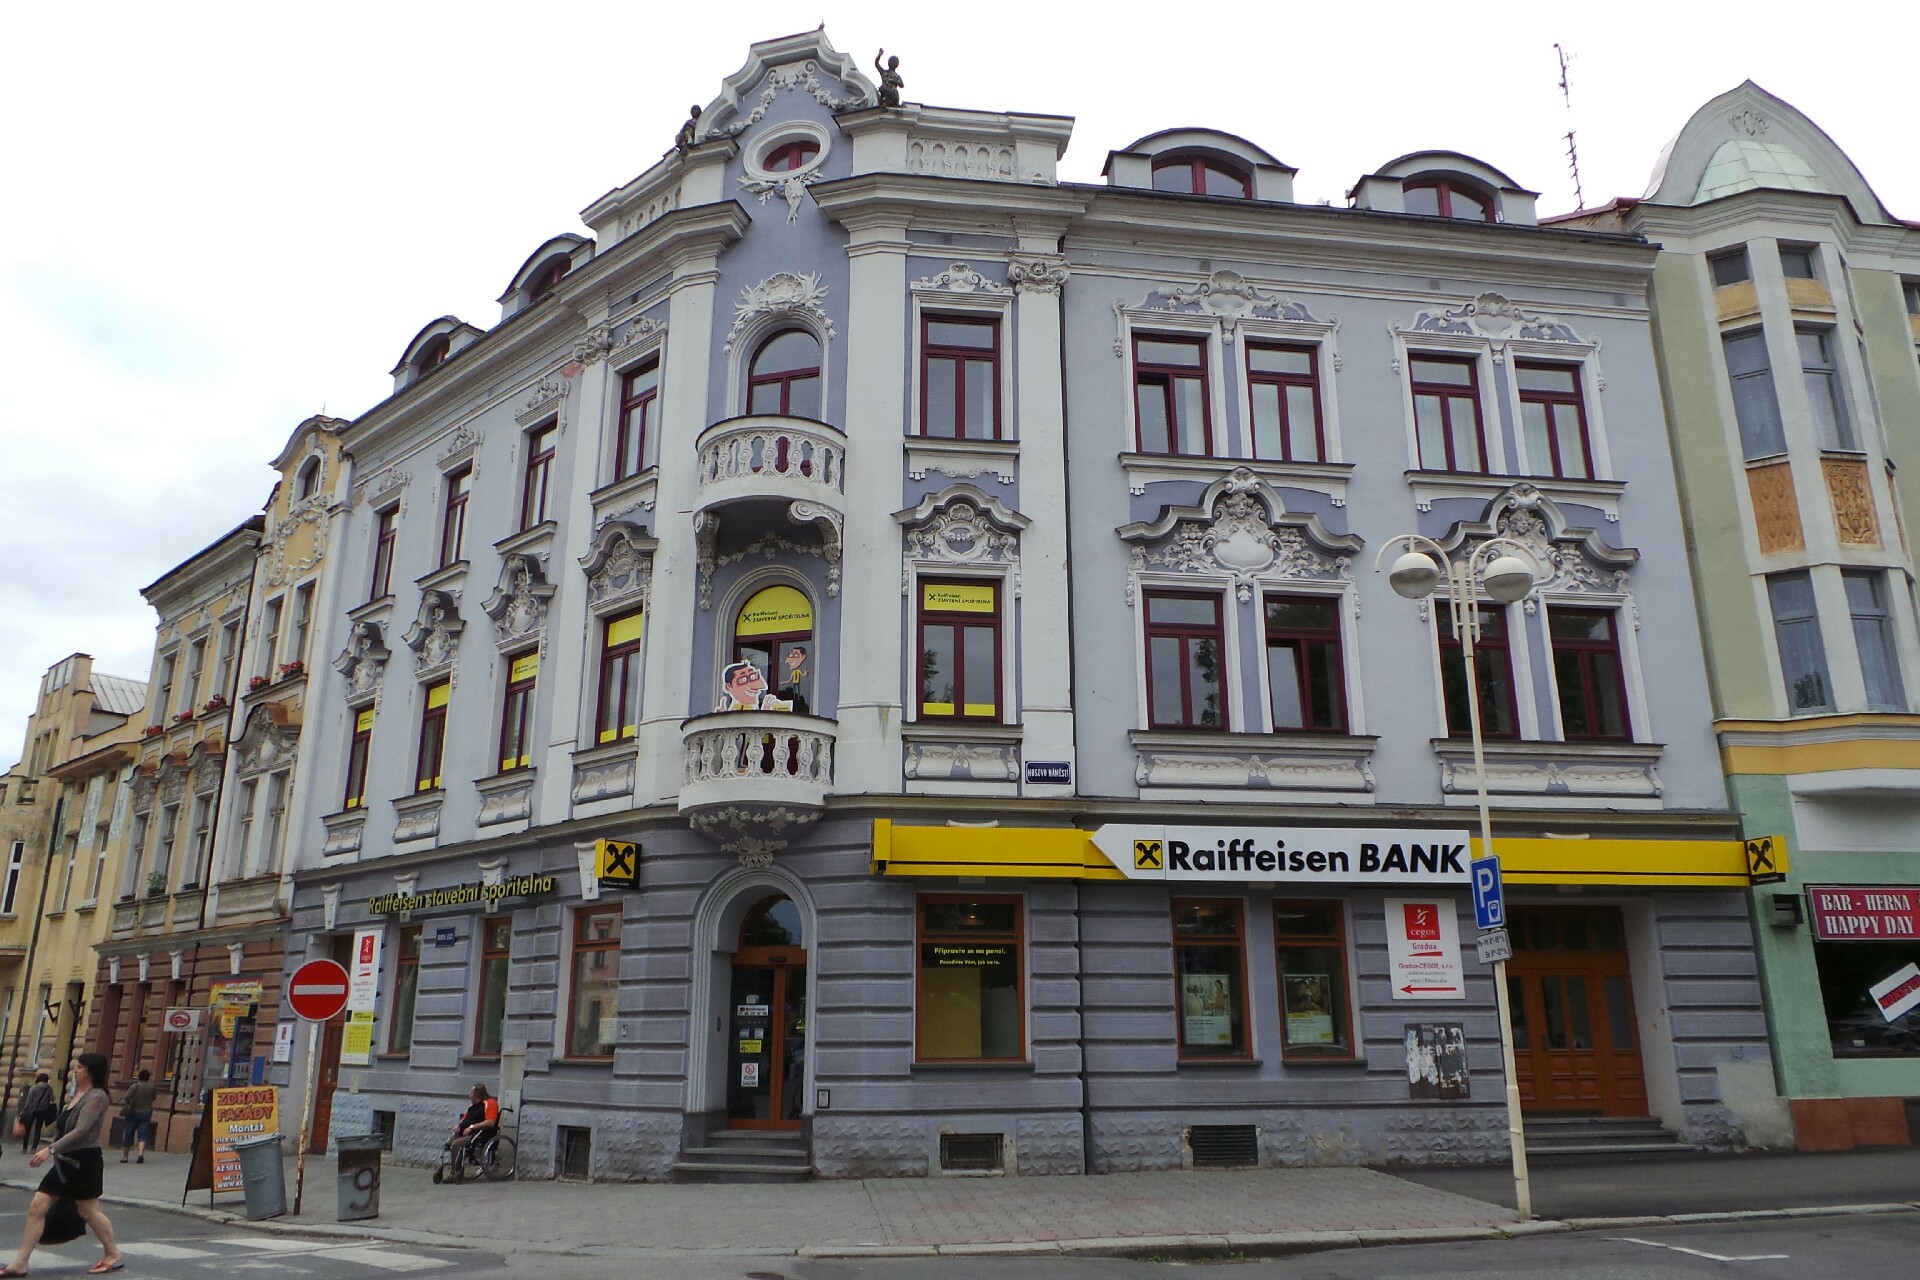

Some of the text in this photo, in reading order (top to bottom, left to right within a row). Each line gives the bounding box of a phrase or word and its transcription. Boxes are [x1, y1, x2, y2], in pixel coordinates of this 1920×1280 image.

[1028, 768, 1047, 777] HUSOVO
[1168, 838, 1466, 874] Raiffeisen BANK
[369, 874, 554, 914] Raiffeisen stavební spořitelna
[1476, 868, 1494, 908] P
[1821, 895, 1852, 911] BAR
[1864, 895, 1911, 911] HERNA
[1825, 916, 1914, 934] HAPPY DAY
[1410, 929, 1436, 938] cegos
[934, 947, 966, 955] Připravte
[217, 1105, 273, 1122] FASÁDY
[229, 1122, 265, 1134] Montáž
